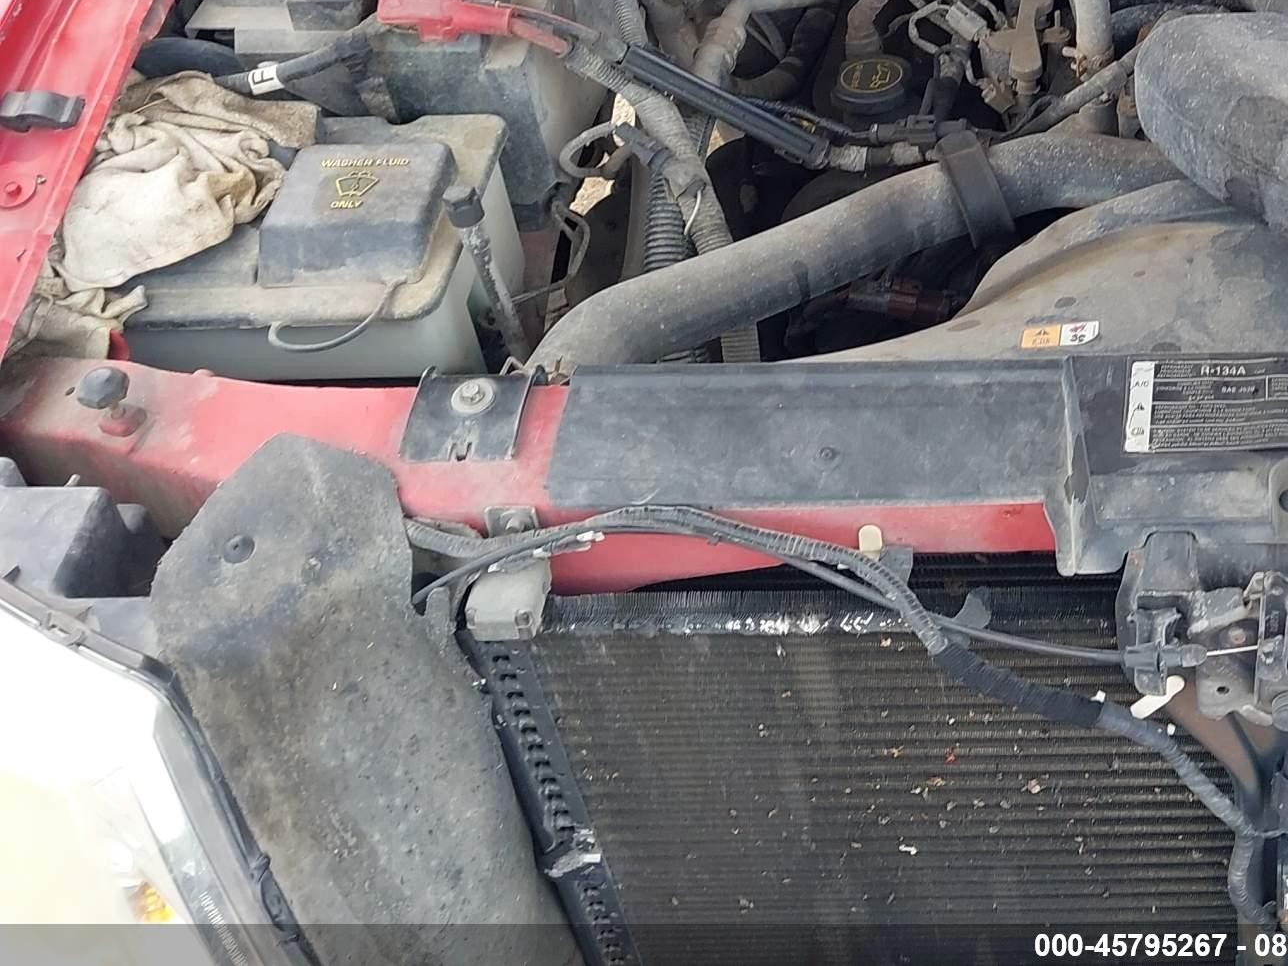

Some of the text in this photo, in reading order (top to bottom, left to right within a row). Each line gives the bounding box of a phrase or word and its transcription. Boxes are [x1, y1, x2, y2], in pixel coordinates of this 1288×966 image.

[321, 157, 410, 167] WASHER FLUID
[330, 200, 363, 209] ONLY
